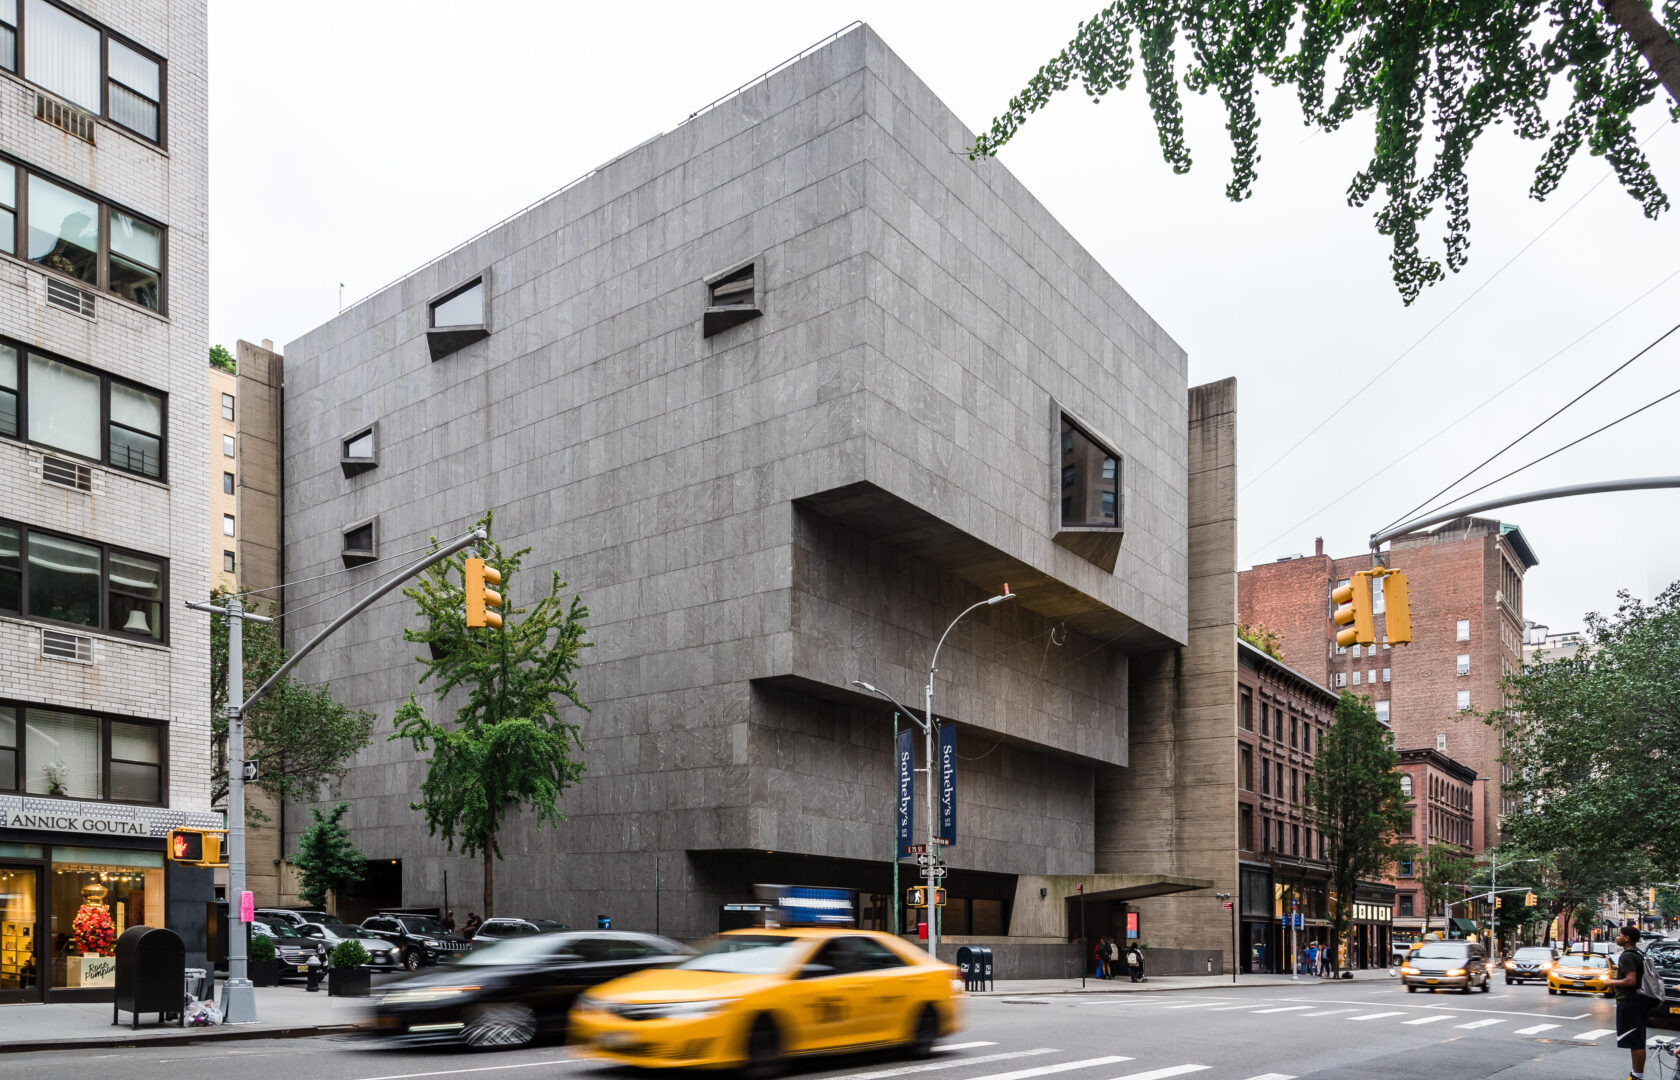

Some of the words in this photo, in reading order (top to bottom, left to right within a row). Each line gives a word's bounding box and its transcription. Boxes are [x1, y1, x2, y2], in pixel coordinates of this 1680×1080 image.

[900, 752, 910, 826] Sotheby's
[942, 745, 953, 815] Sotheby's
[11, 814, 79, 830] ANNICK
[82, 819, 147, 835] GOUTAL
[88, 961, 109, 972] Rose
